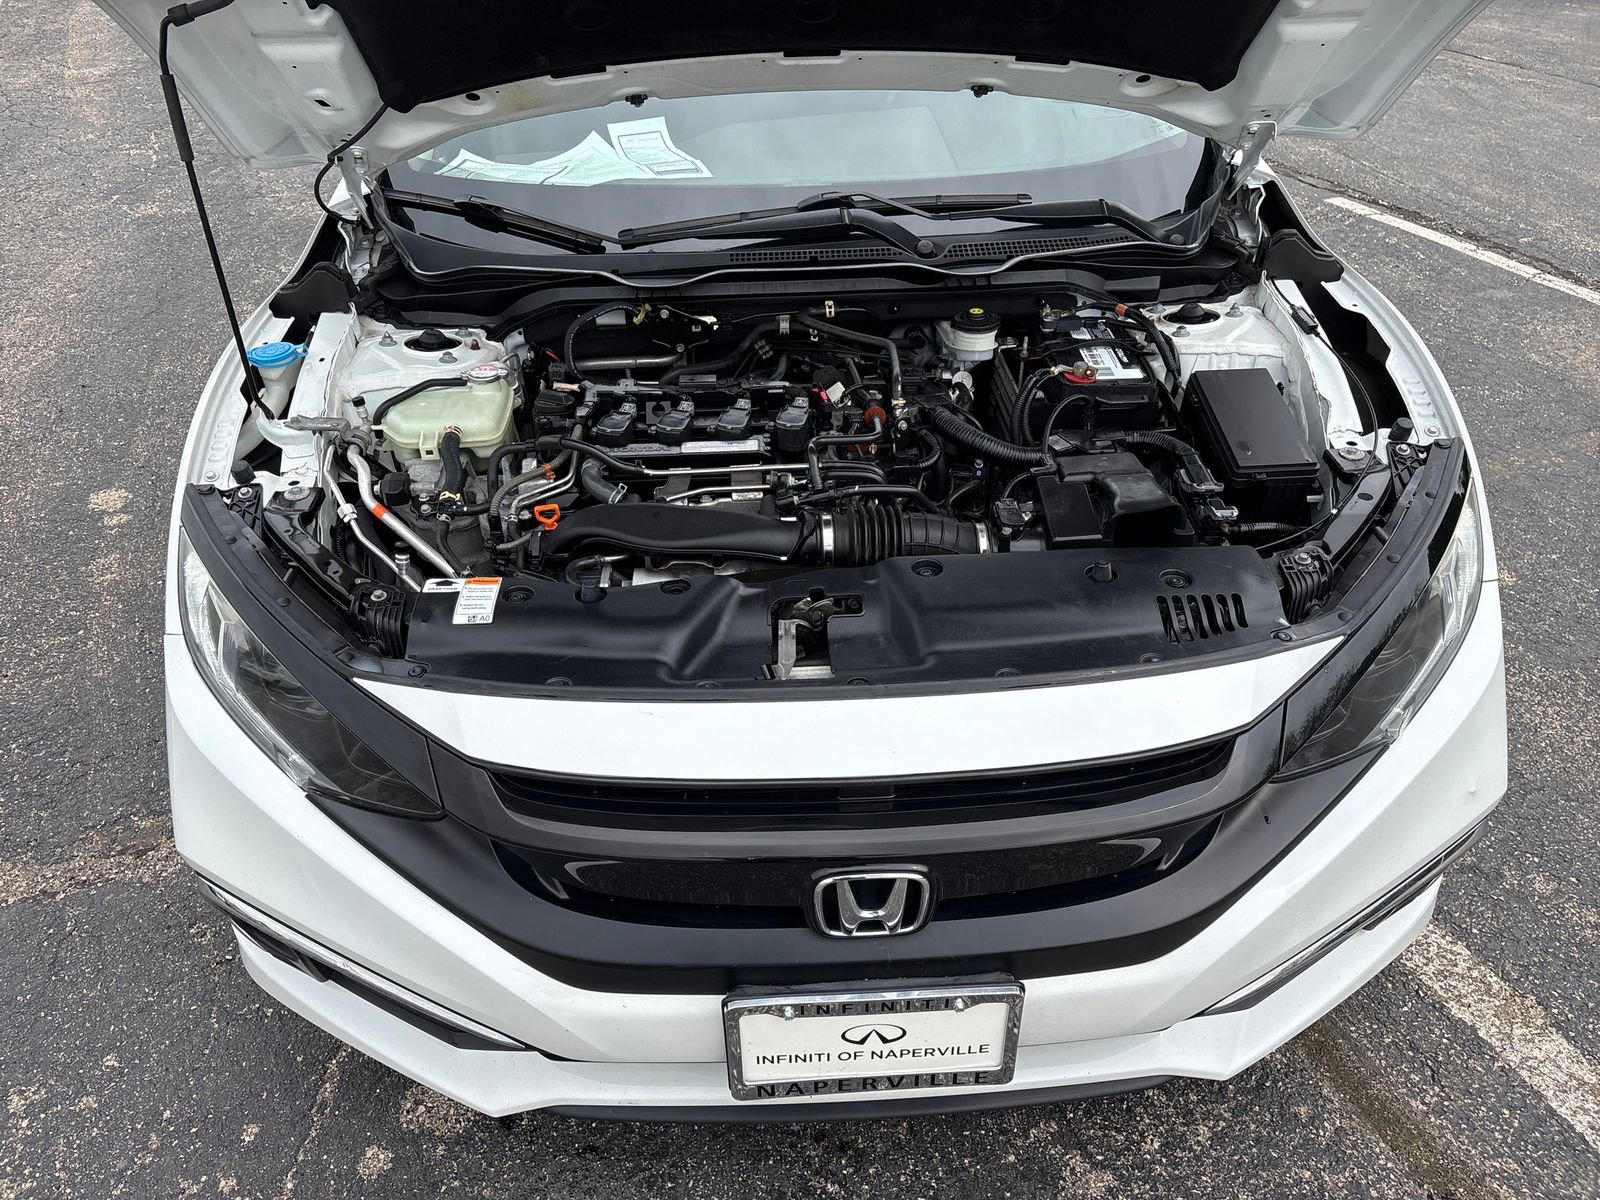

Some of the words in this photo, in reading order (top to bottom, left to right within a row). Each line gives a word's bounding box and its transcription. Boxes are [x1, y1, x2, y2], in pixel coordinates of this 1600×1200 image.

[800, 998, 950, 1016] INFINITI
[756, 1052, 831, 1065] INFINITI
[837, 1052, 864, 1062] OF
[870, 1043, 990, 1060] NAPERVILLE
[757, 1071, 989, 1098] NAPERVILLE
